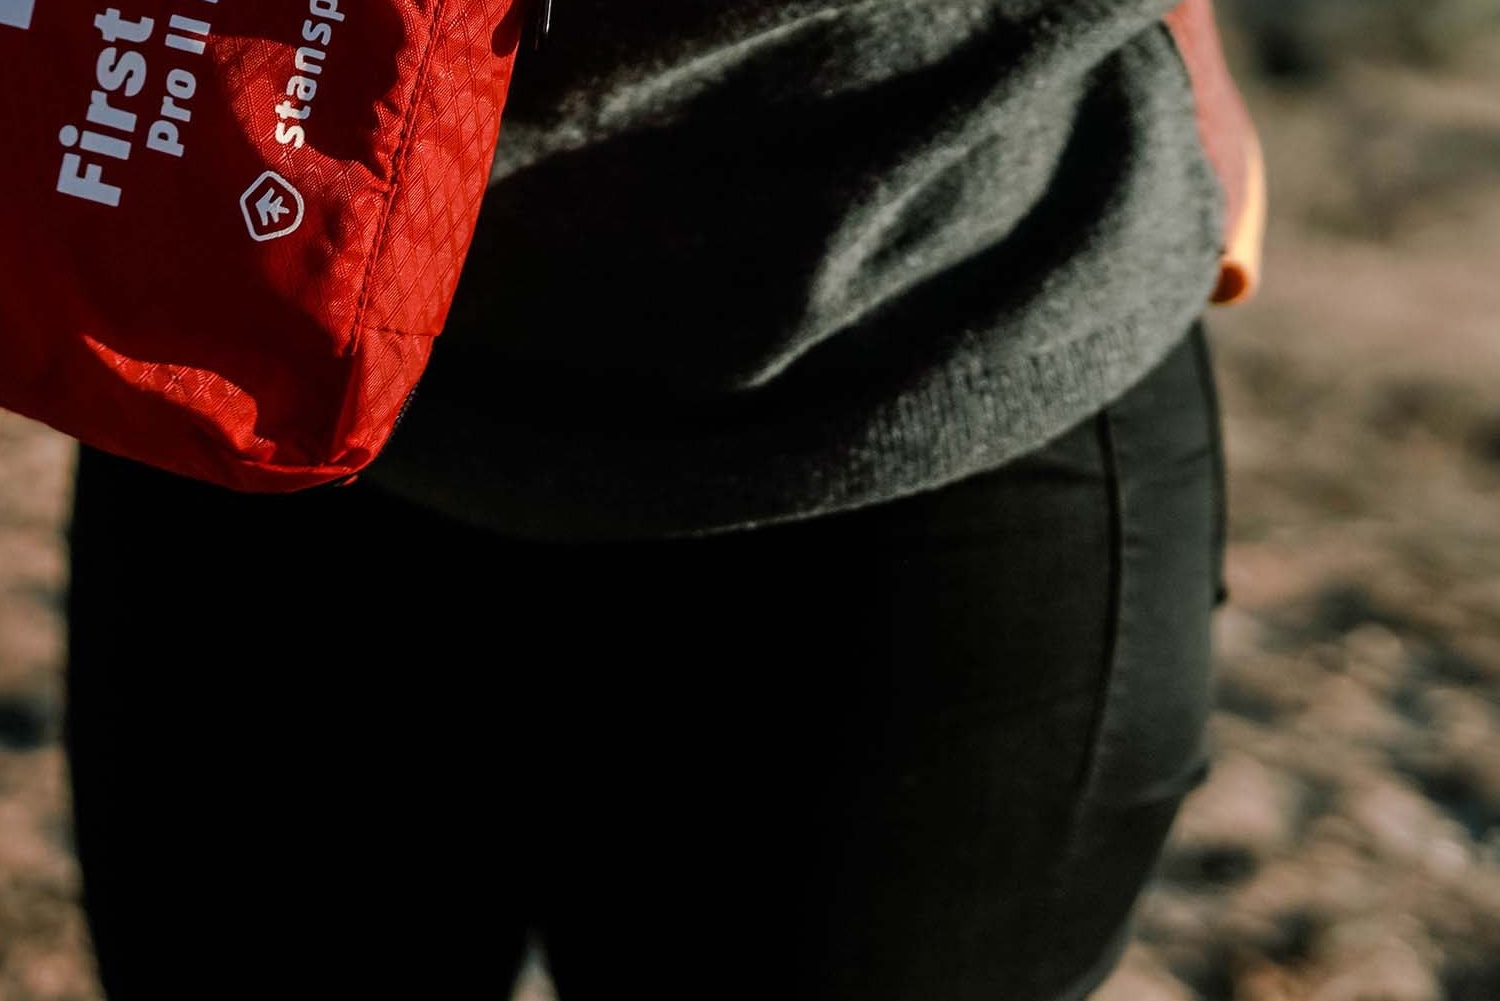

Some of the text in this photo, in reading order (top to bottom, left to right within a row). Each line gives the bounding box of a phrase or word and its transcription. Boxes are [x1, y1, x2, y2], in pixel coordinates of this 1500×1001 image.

[165, 14, 211, 54] II
[56, 8, 154, 207] First
[146, 68, 197, 157] Pro
